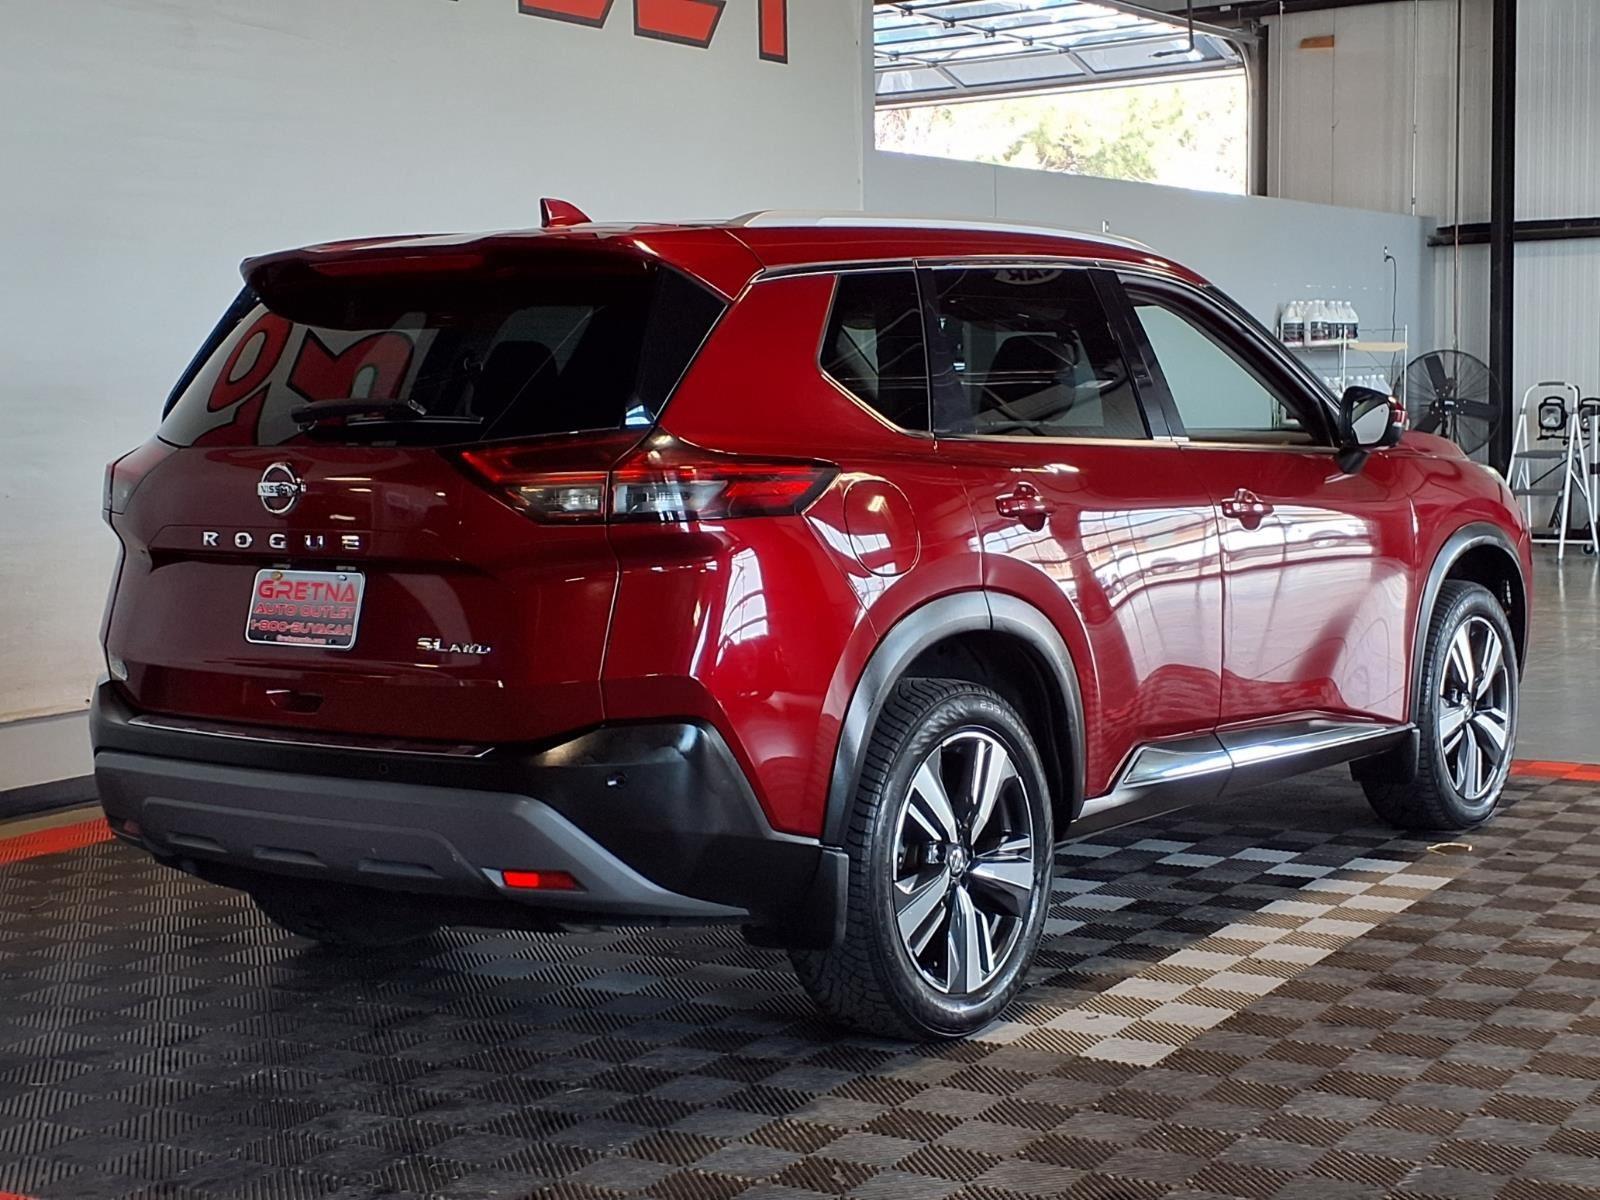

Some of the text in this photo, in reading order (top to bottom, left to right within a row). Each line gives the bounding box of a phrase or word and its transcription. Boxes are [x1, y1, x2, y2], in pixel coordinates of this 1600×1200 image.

[203, 531, 360, 549] ROGUE
[258, 580, 356, 602] GRETNA
[254, 602, 355, 619] AUTO OUTLET
[416, 637, 448, 652] SL
